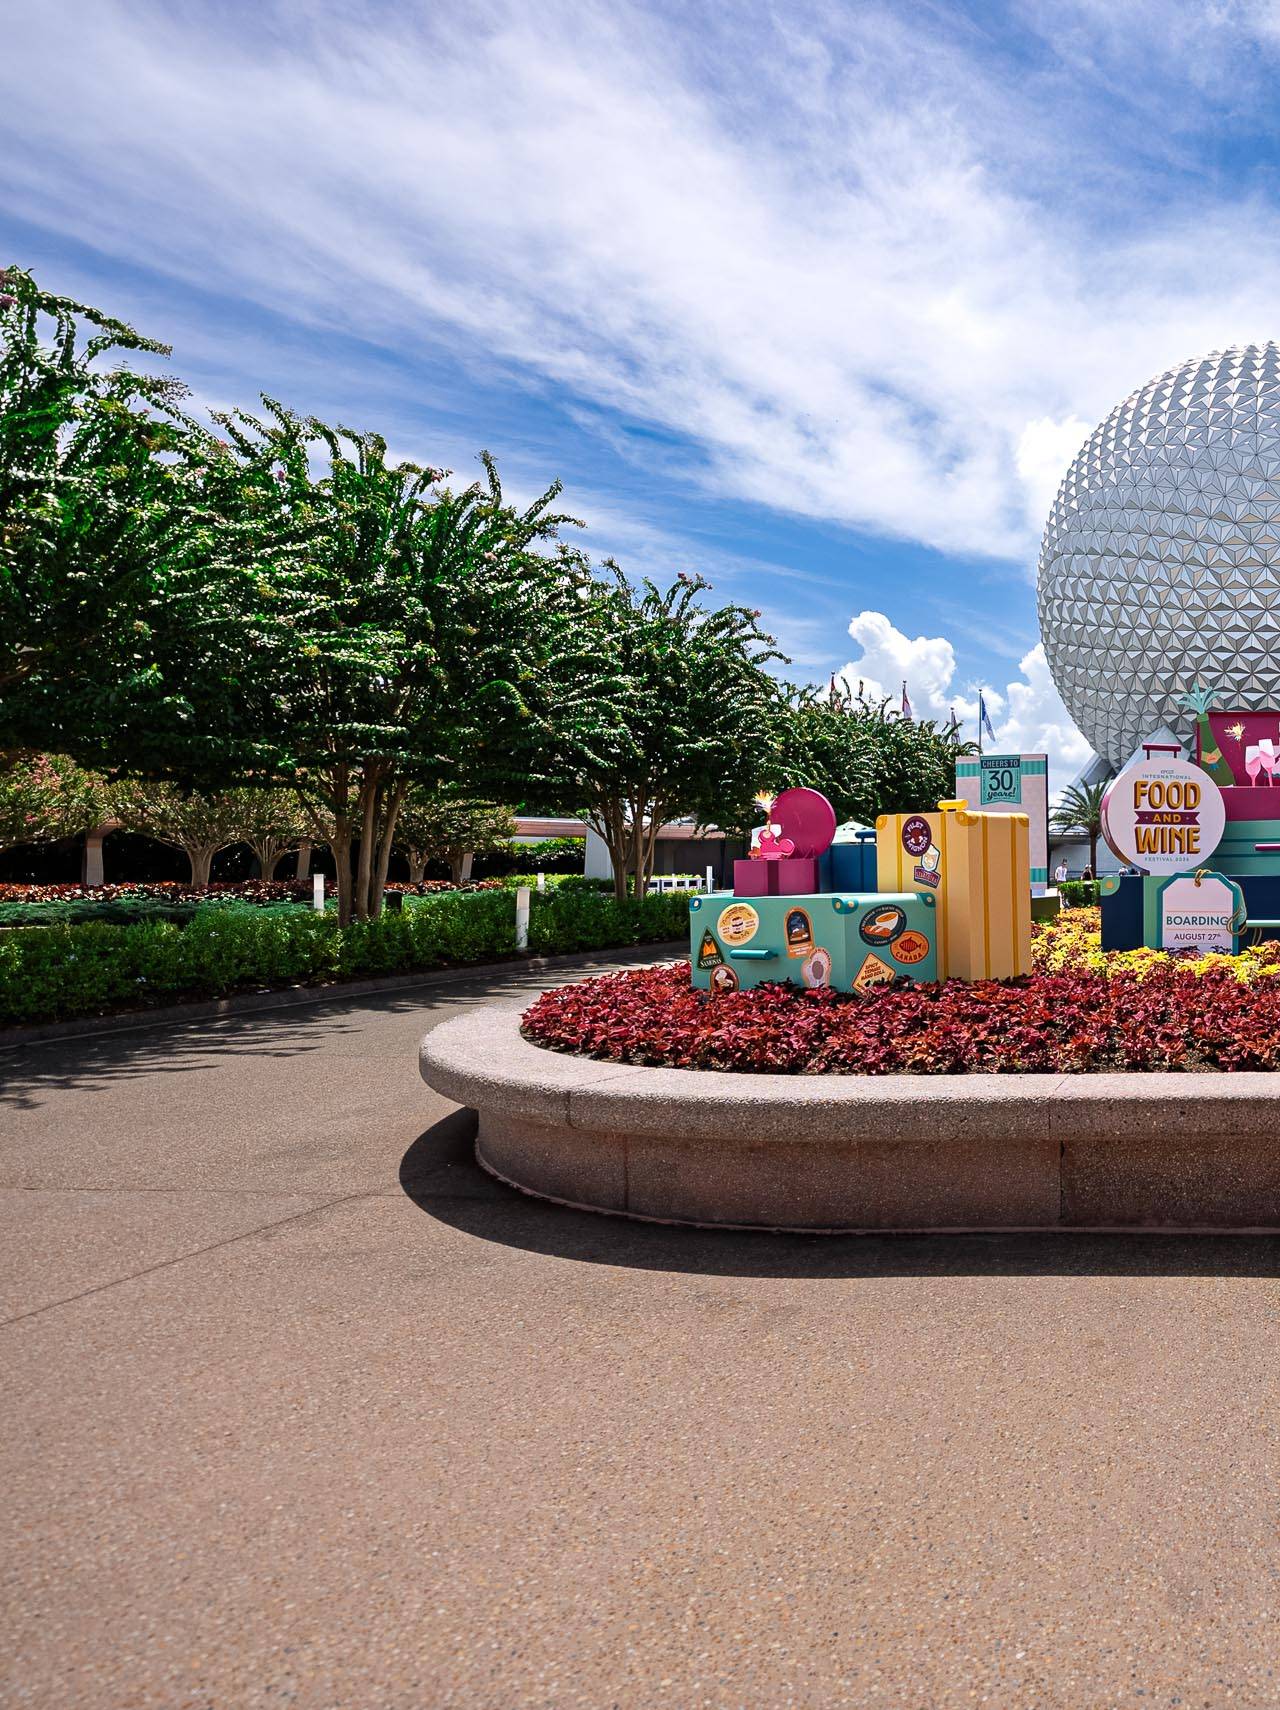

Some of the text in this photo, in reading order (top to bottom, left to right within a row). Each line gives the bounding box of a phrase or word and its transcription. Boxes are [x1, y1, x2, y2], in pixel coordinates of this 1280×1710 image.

[982, 760, 1008, 768] CHEERS
[988, 770, 1013, 791] 30
[987, 787, 1016, 801] years!
[1134, 781, 1201, 810] FOOD
[1153, 813, 1181, 823] AND
[907, 821, 924, 832] FILET
[906, 836, 929, 852] MIGNON
[1134, 827, 1201, 854] WINE
[1166, 916, 1229, 926] BOARDING
[1174, 933, 1206, 941] AUGUST
[895, 951, 923, 960] CANADA
